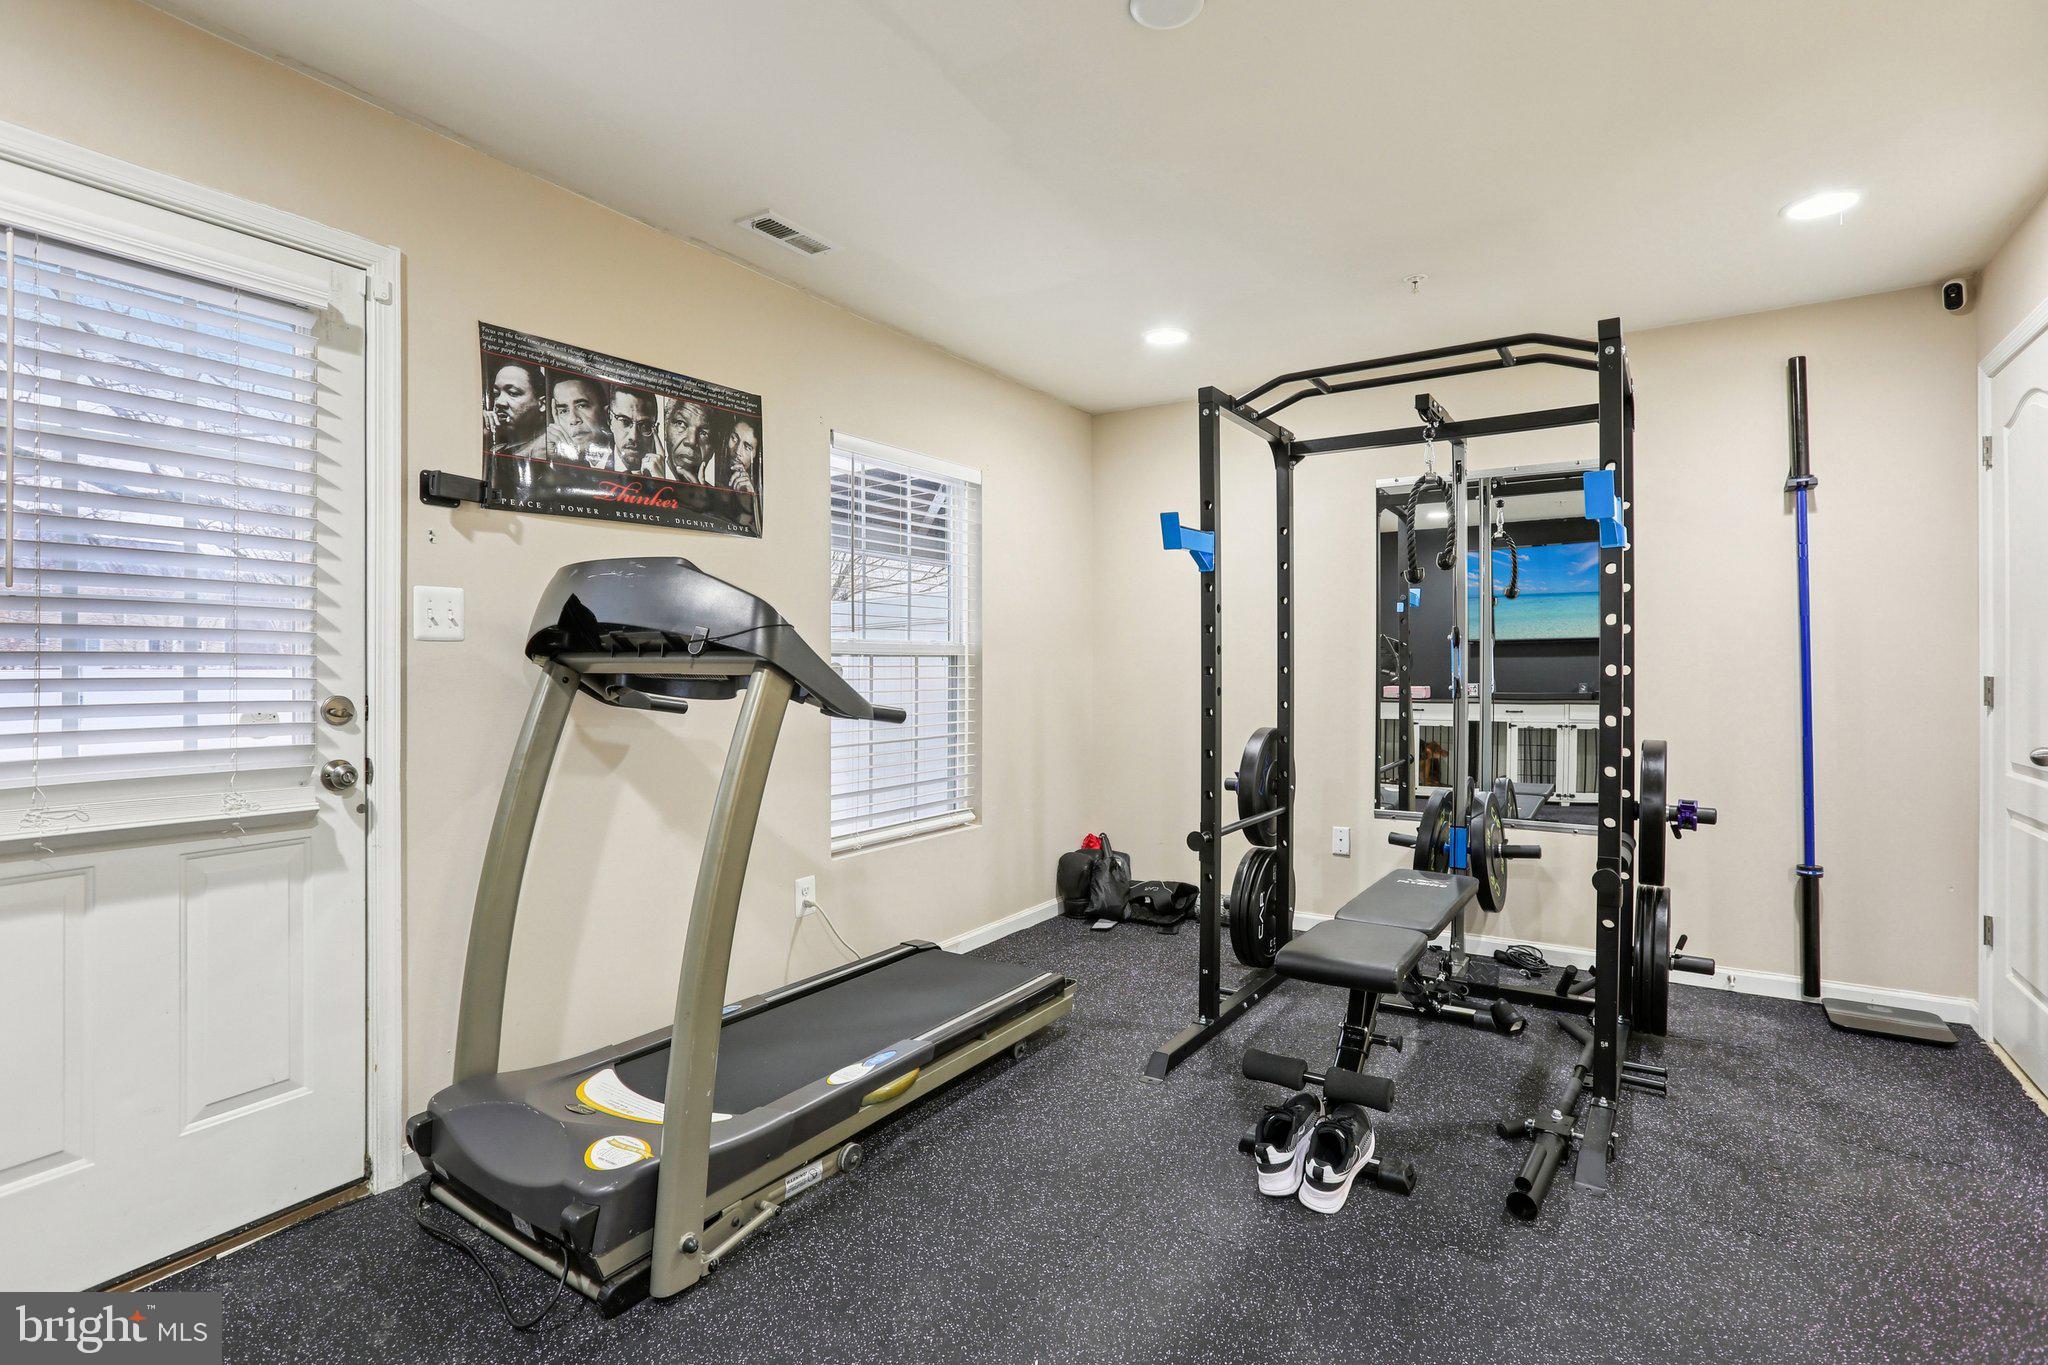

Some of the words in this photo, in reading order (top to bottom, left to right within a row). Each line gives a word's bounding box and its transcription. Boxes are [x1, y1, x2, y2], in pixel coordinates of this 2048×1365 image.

[501, 498, 542, 509] PEACE
[560, 504, 599, 515] POWER
[616, 511, 660, 522] RESPECT
[675, 518, 715, 528] DIGNITY
[727, 523, 749, 533] LOVE
